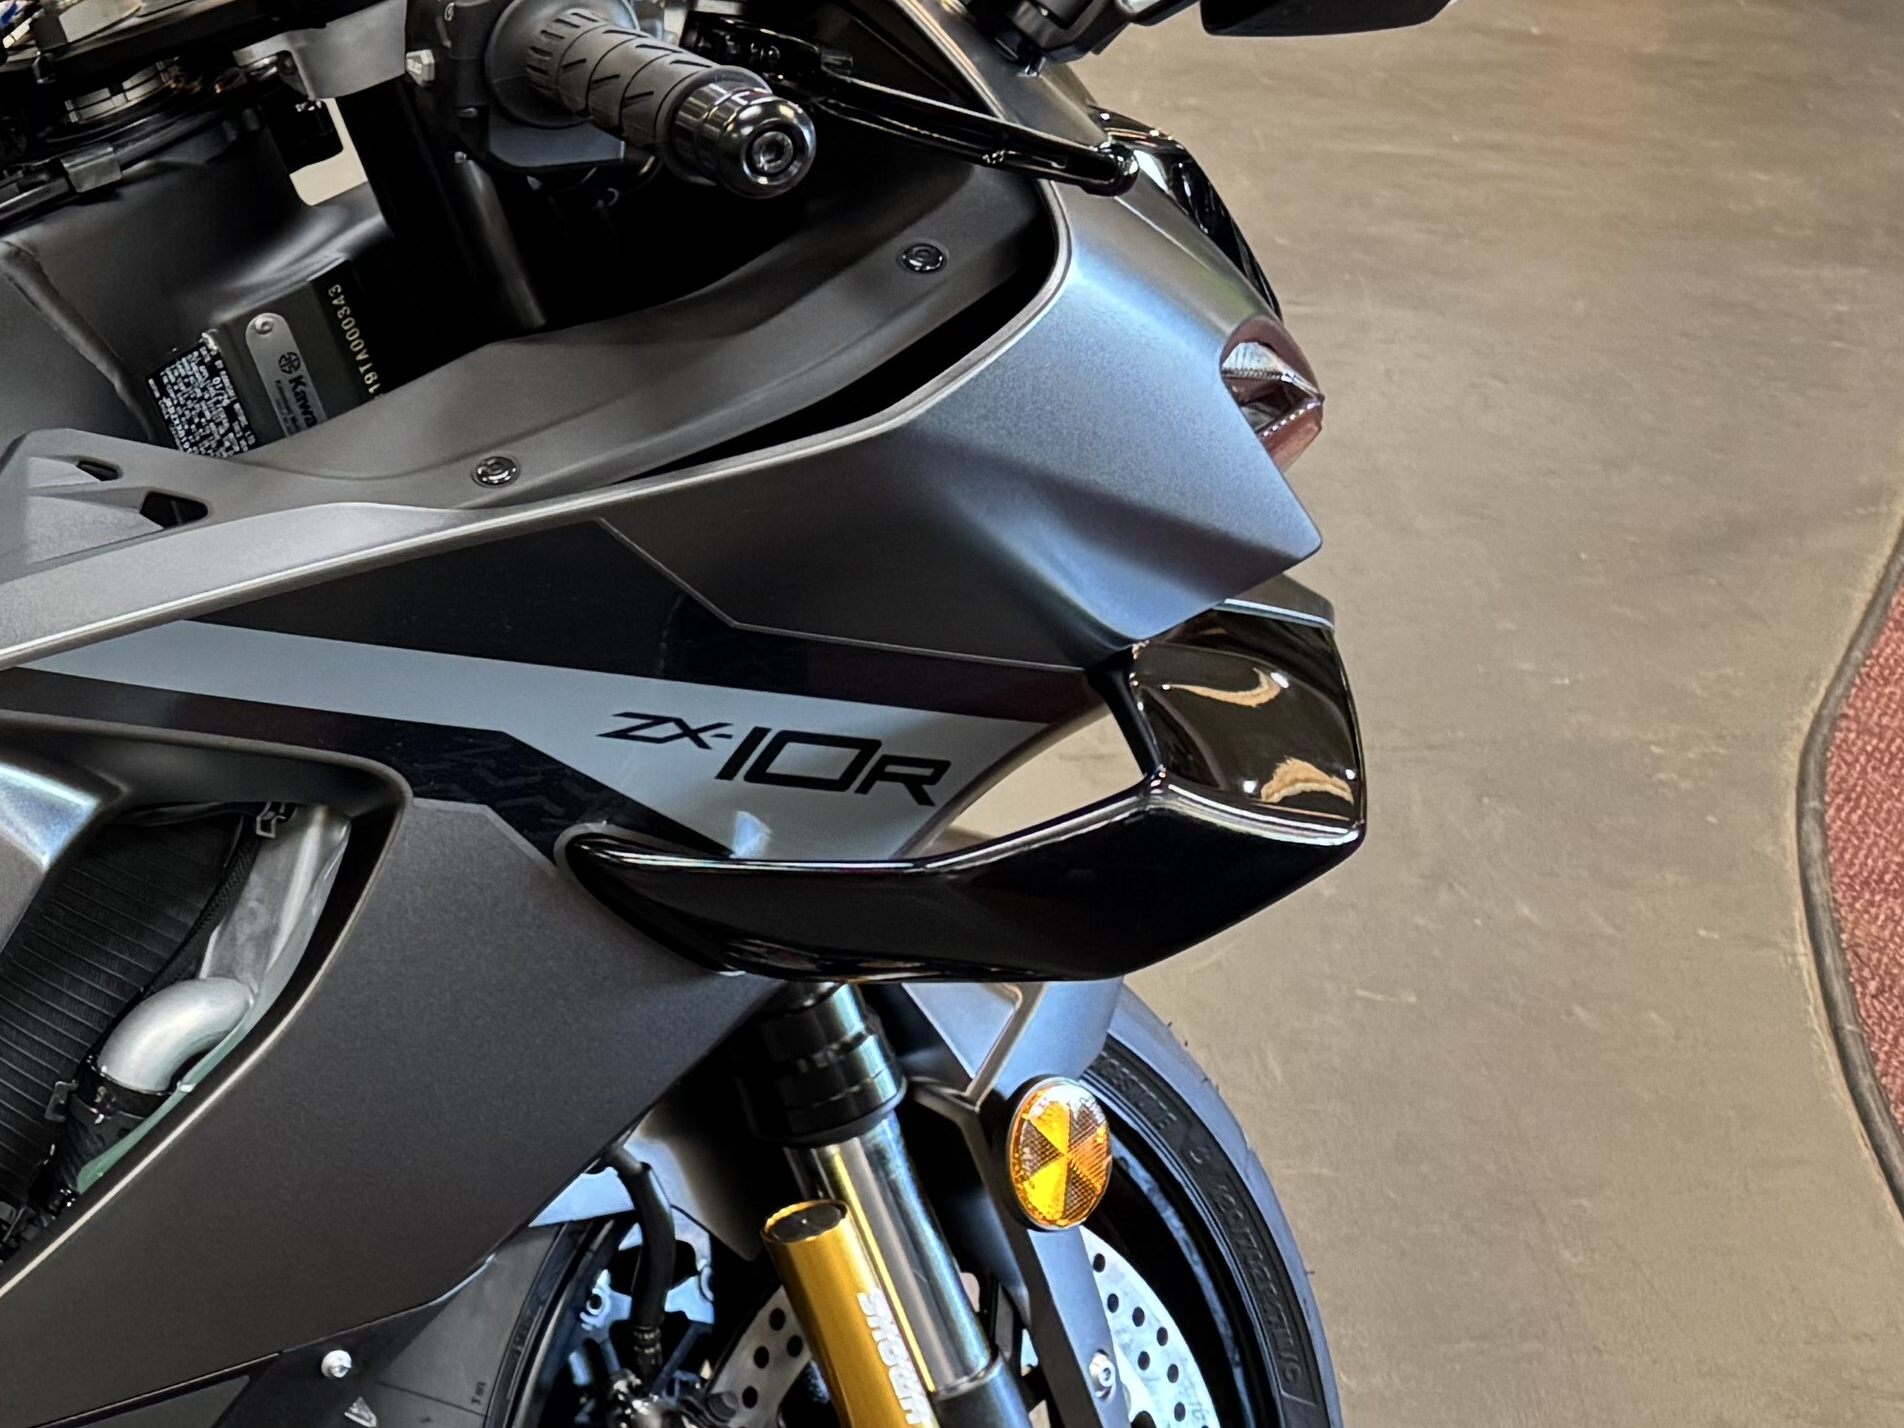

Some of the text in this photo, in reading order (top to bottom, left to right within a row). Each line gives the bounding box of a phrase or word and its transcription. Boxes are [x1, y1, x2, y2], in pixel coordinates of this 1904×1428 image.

[289, 374, 318, 428] Kawa
[597, 711, 952, 807] ZX-10R
[855, 1290, 926, 1427] SHOWA
